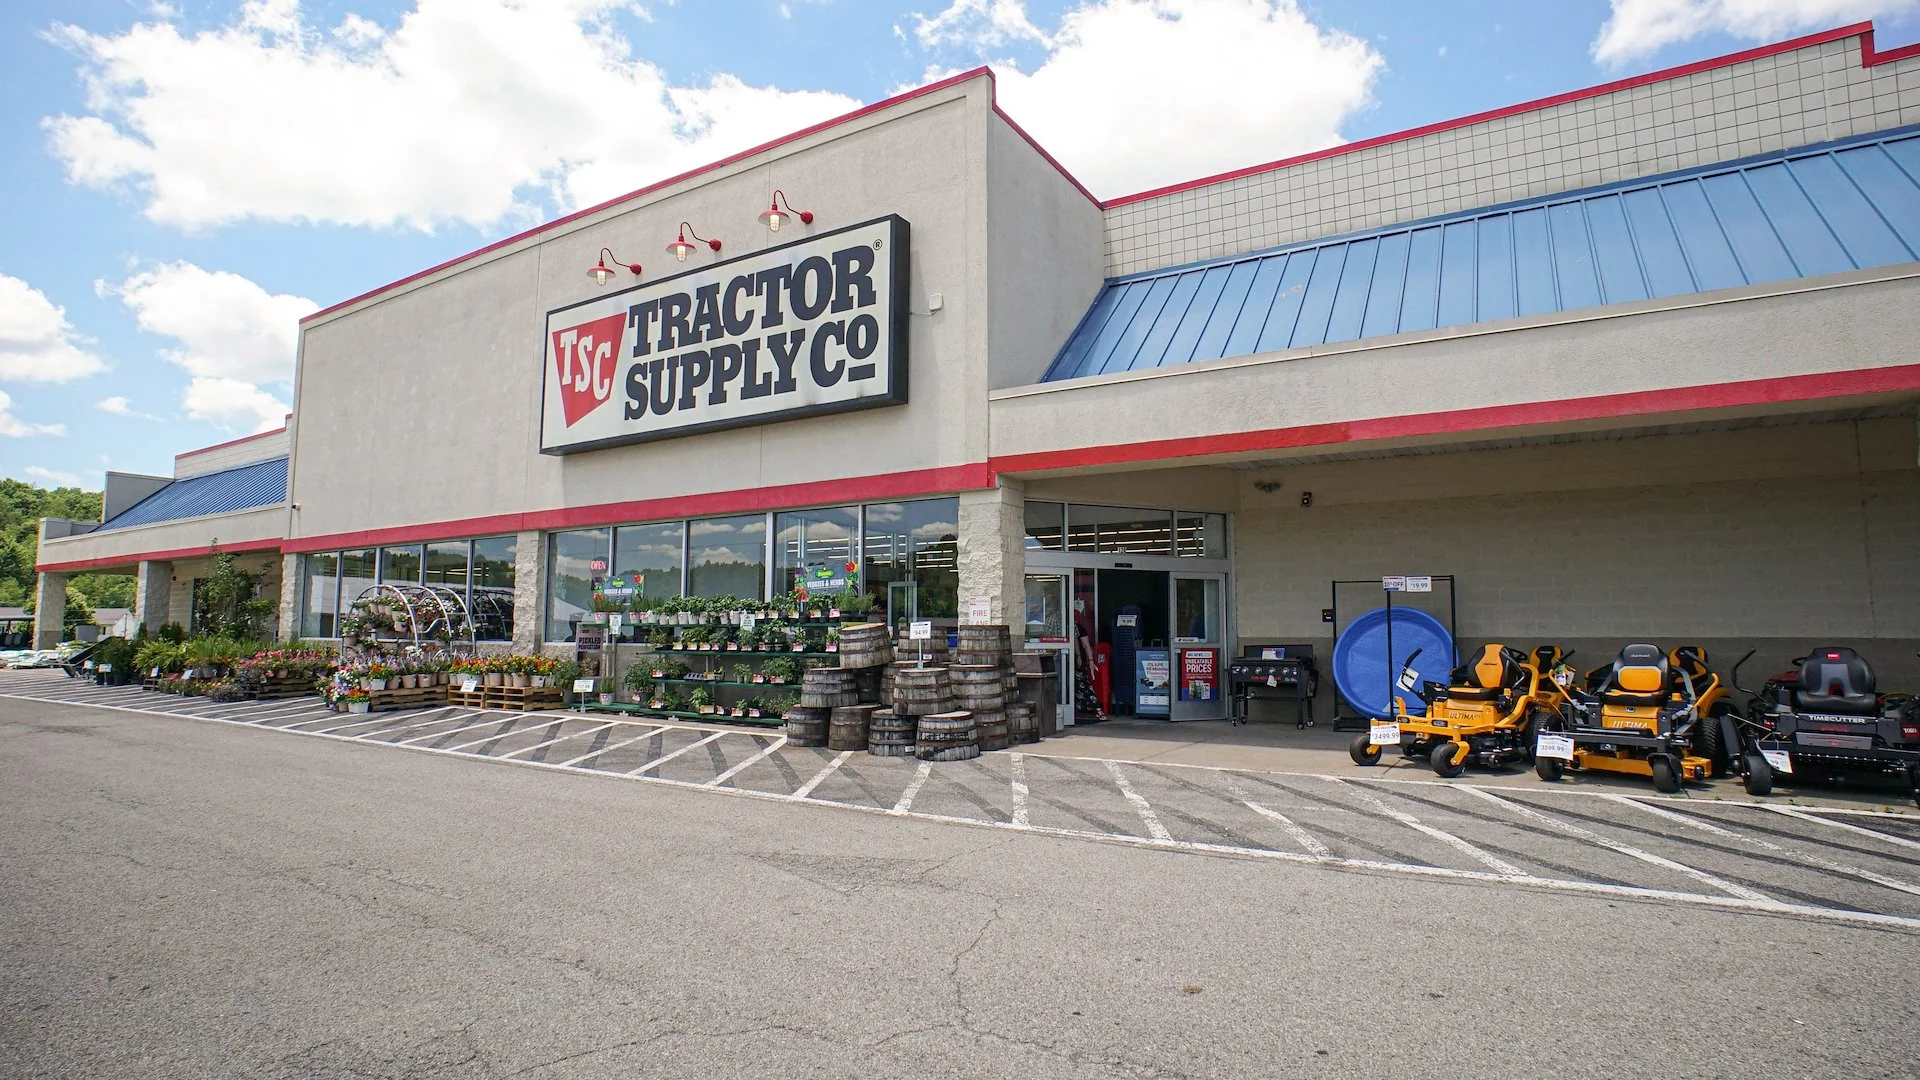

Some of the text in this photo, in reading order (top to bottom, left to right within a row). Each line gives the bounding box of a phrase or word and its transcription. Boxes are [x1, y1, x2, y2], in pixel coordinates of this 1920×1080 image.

[628, 245, 877, 358] TRACTOR
[559, 329, 612, 401] TSC
[624, 328, 806, 421] SUPPLY
[590, 560, 607, 570] OPEN
[1186, 664, 1212, 673] PRICES
[1449, 712, 1474, 721] ULTIMA
[1808, 715, 1866, 724] TIMECUTTER
